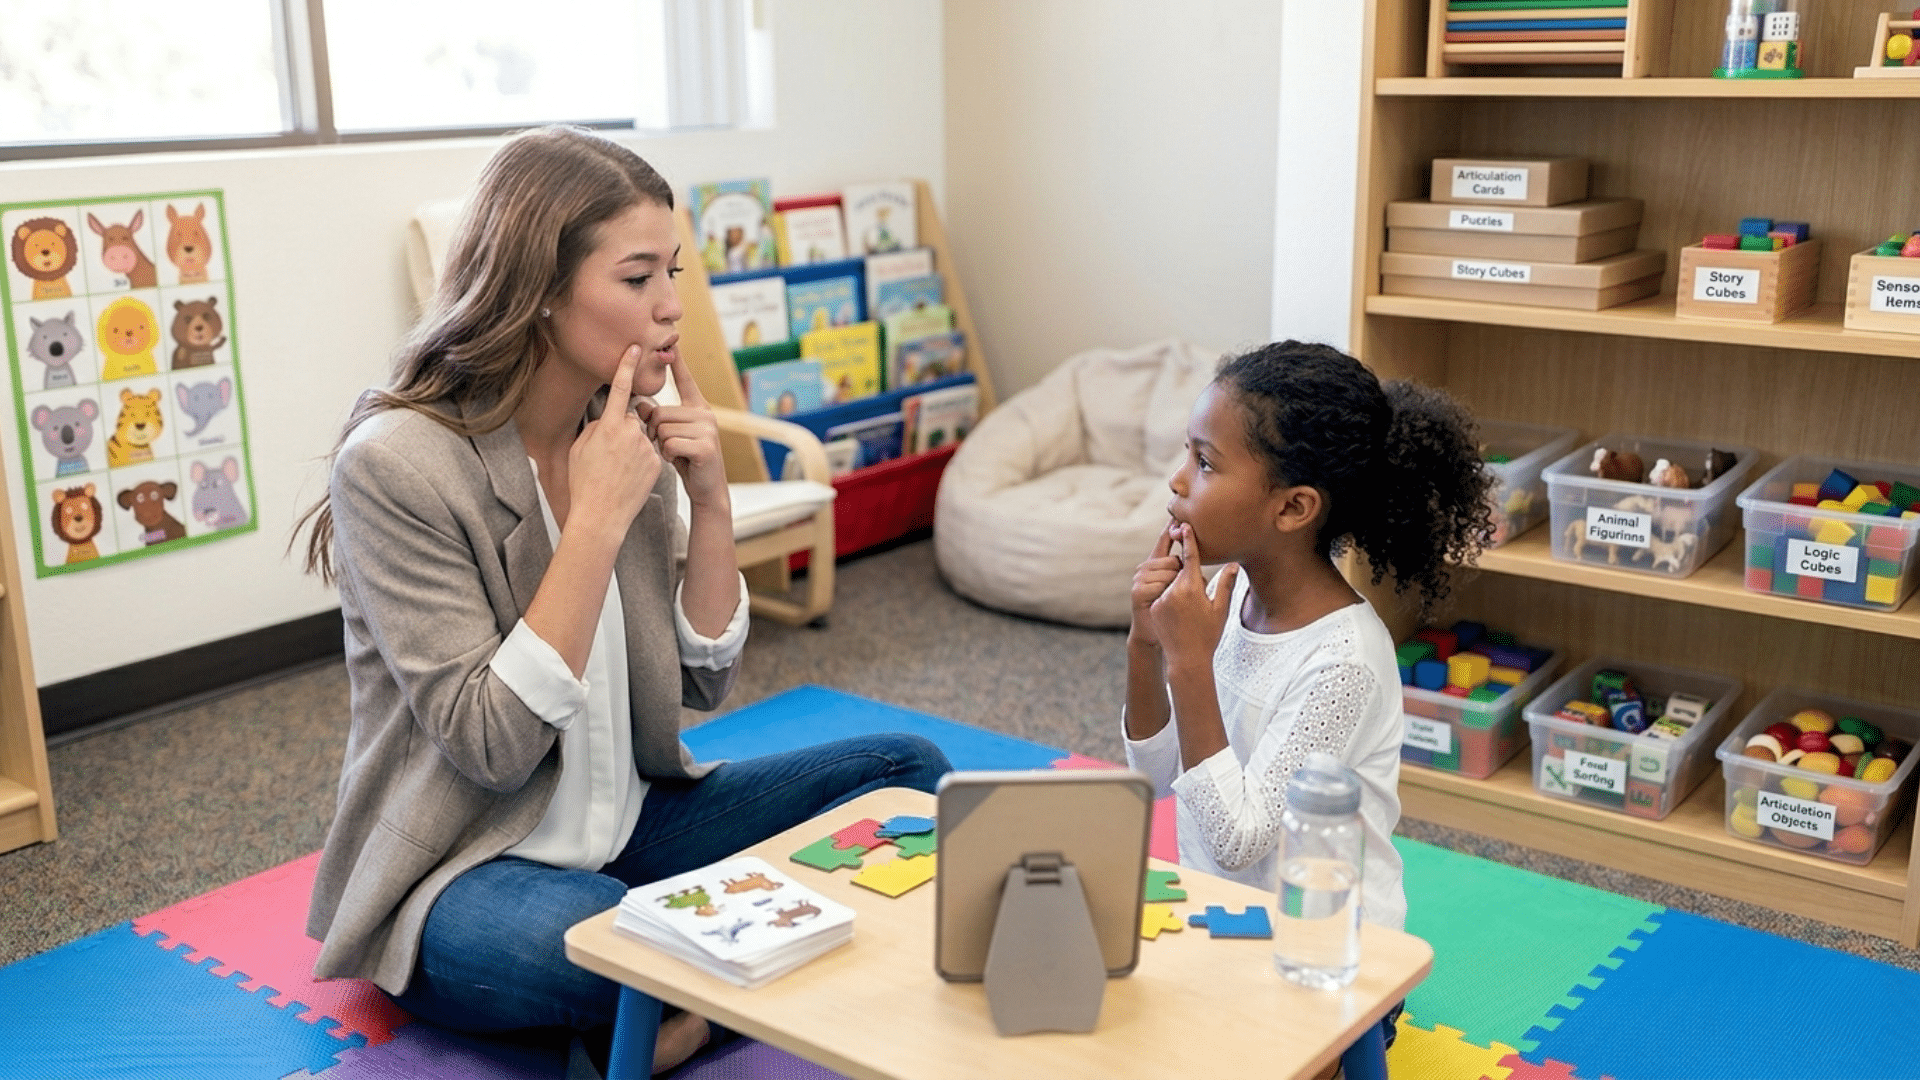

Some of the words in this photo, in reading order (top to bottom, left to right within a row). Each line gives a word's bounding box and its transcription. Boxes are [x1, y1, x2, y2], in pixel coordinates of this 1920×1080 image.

[1457, 170, 1522, 182] Articulation
[1472, 183, 1505, 195] Cards
[1457, 264, 1486, 279] Story
[1489, 266, 1526, 279] Cubes
[1709, 271, 1744, 287] Story
[1705, 286, 1747, 299] Cubes
[1598, 513, 1640, 528] Animal
[1804, 545, 1841, 561] Logic
[1800, 559, 1842, 575] Cubes
[1760, 796, 1832, 820] Articulation
[1771, 812, 1819, 831] Objects
